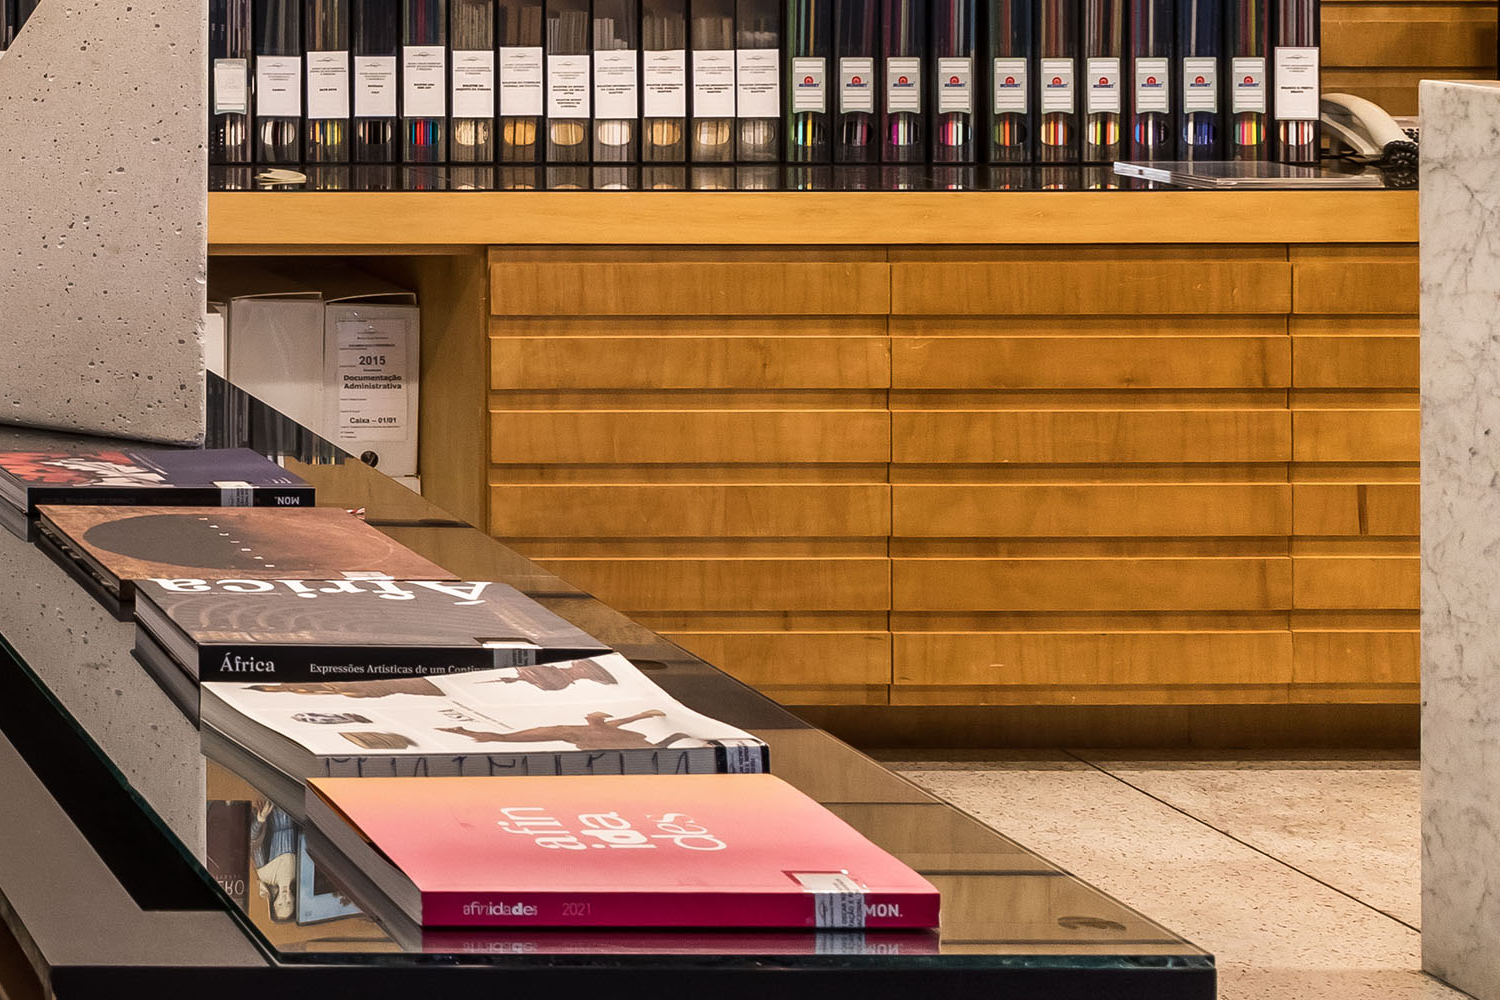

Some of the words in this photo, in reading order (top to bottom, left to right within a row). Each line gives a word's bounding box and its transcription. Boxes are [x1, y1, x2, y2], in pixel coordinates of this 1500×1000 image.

[358, 355, 386, 366] 2015
[343, 374, 402, 383] Documentação
[343, 382, 402, 390] Administrativa
[219, 653, 276, 675] África
[309, 662, 364, 675] Expressões
[366, 661, 413, 675] Artísticas
[414, 665, 428, 675] de
[462, 901, 538, 916] afinidades
[562, 902, 591, 916] 2021
[864, 903, 904, 918] MON.
